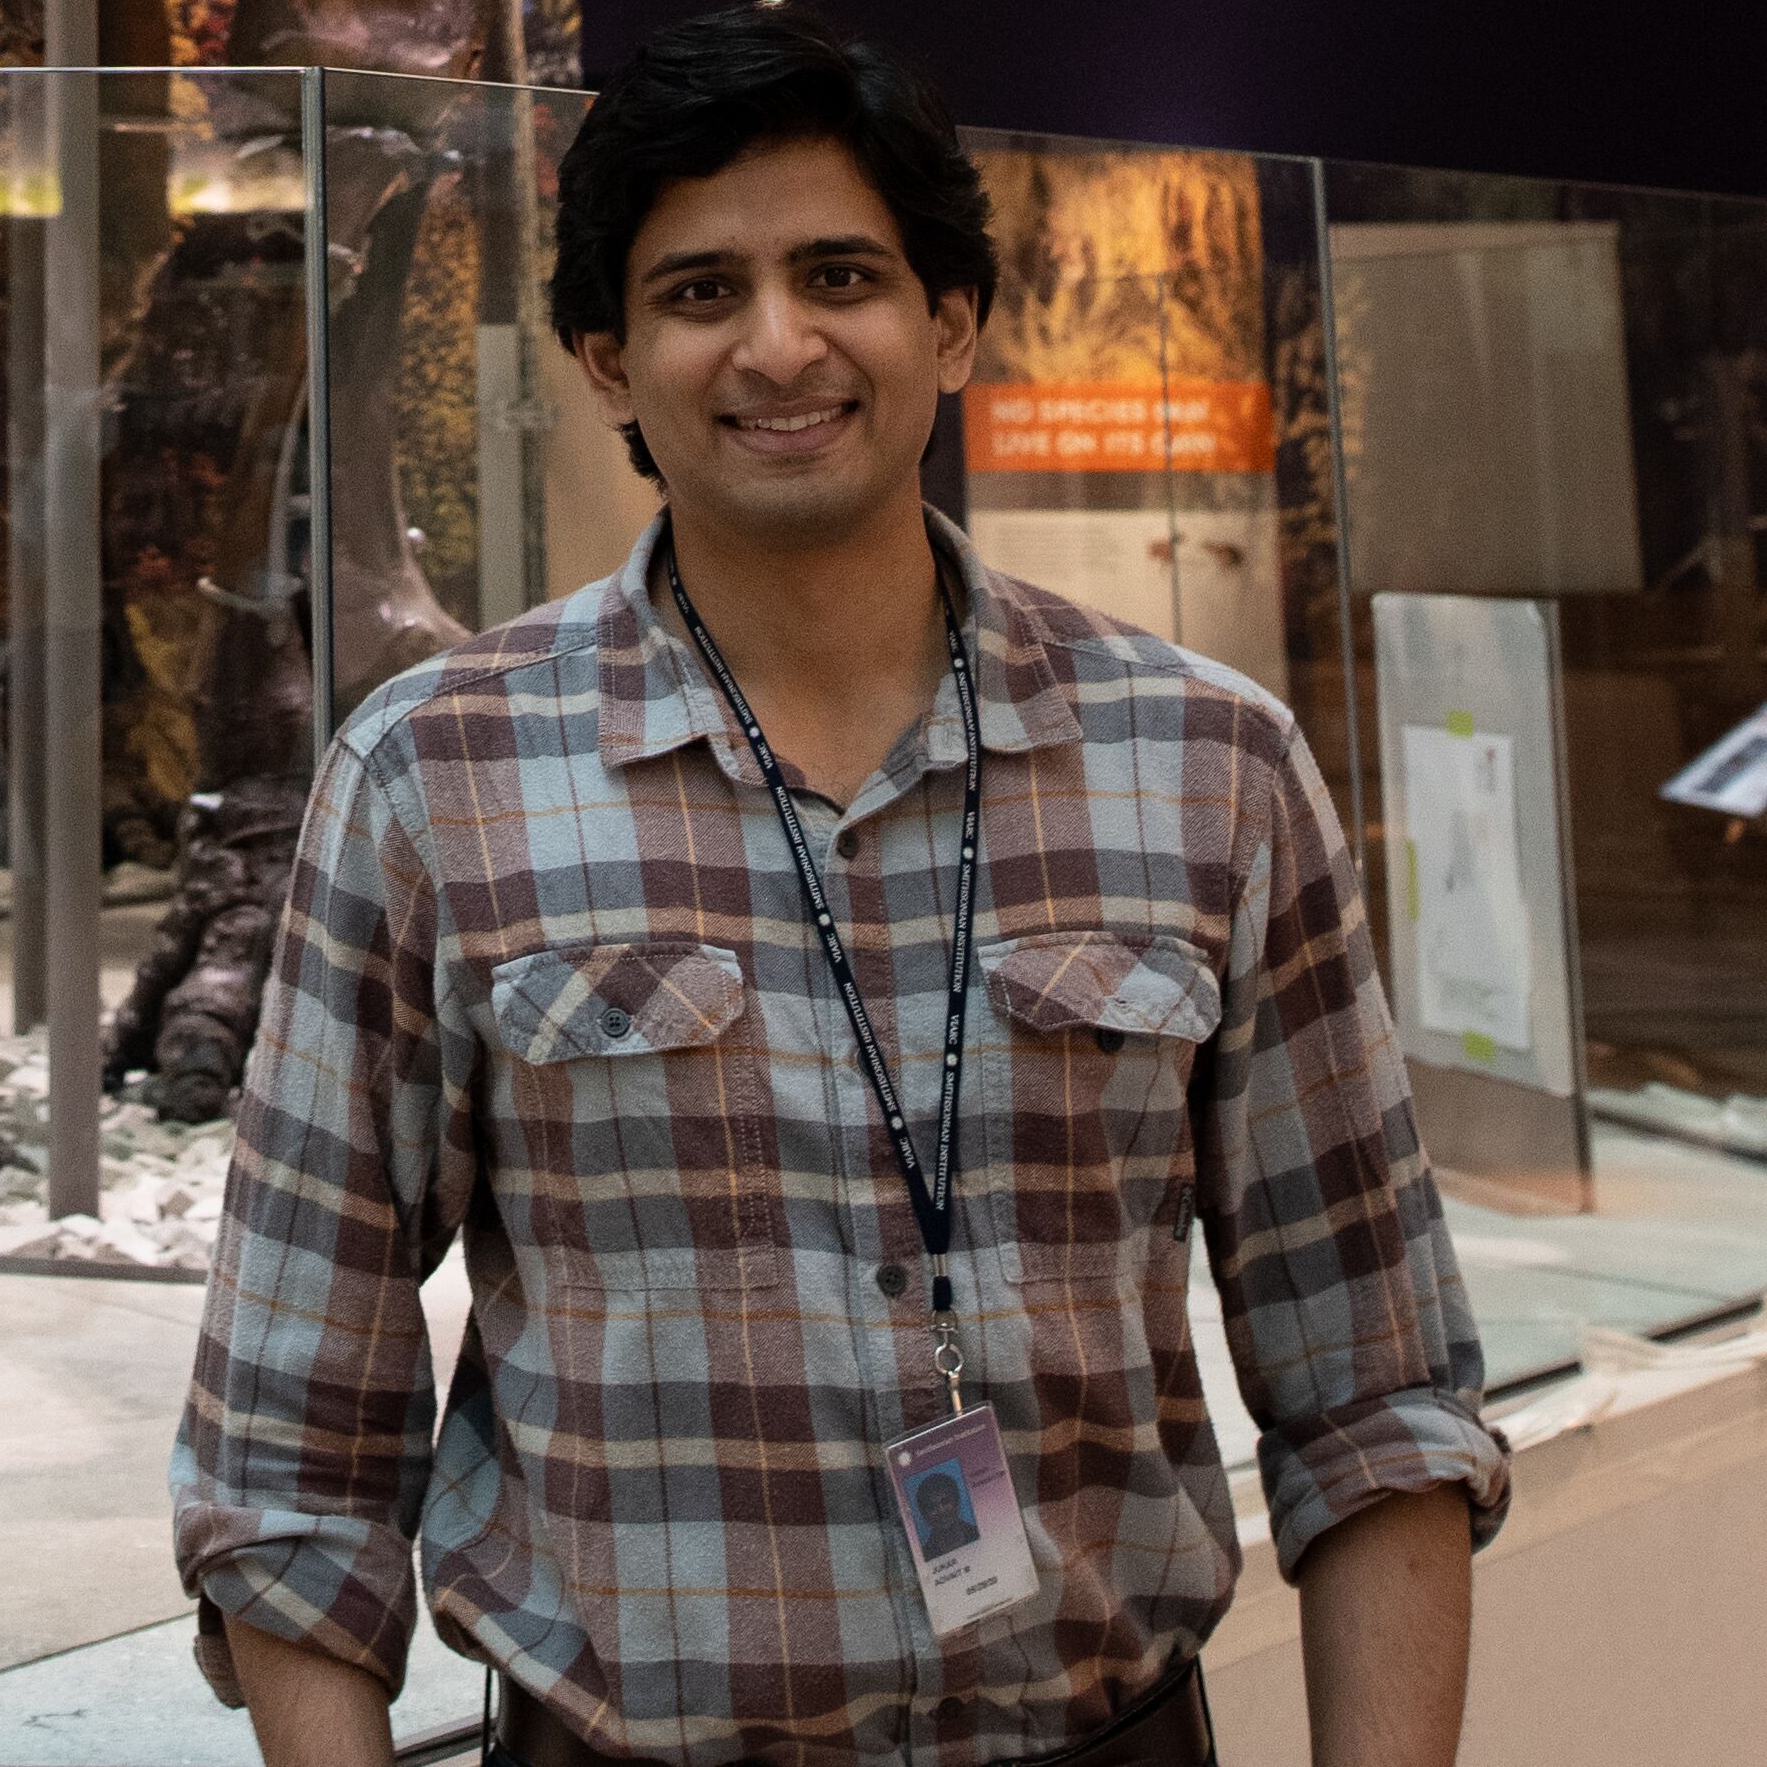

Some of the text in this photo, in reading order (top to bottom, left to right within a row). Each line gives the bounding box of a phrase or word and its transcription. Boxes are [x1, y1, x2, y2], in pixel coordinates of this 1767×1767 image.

[773, 785, 843, 962] VIARC SMITHSONIAN INSTITUTION
[897, 1136, 917, 1168] VIARC
